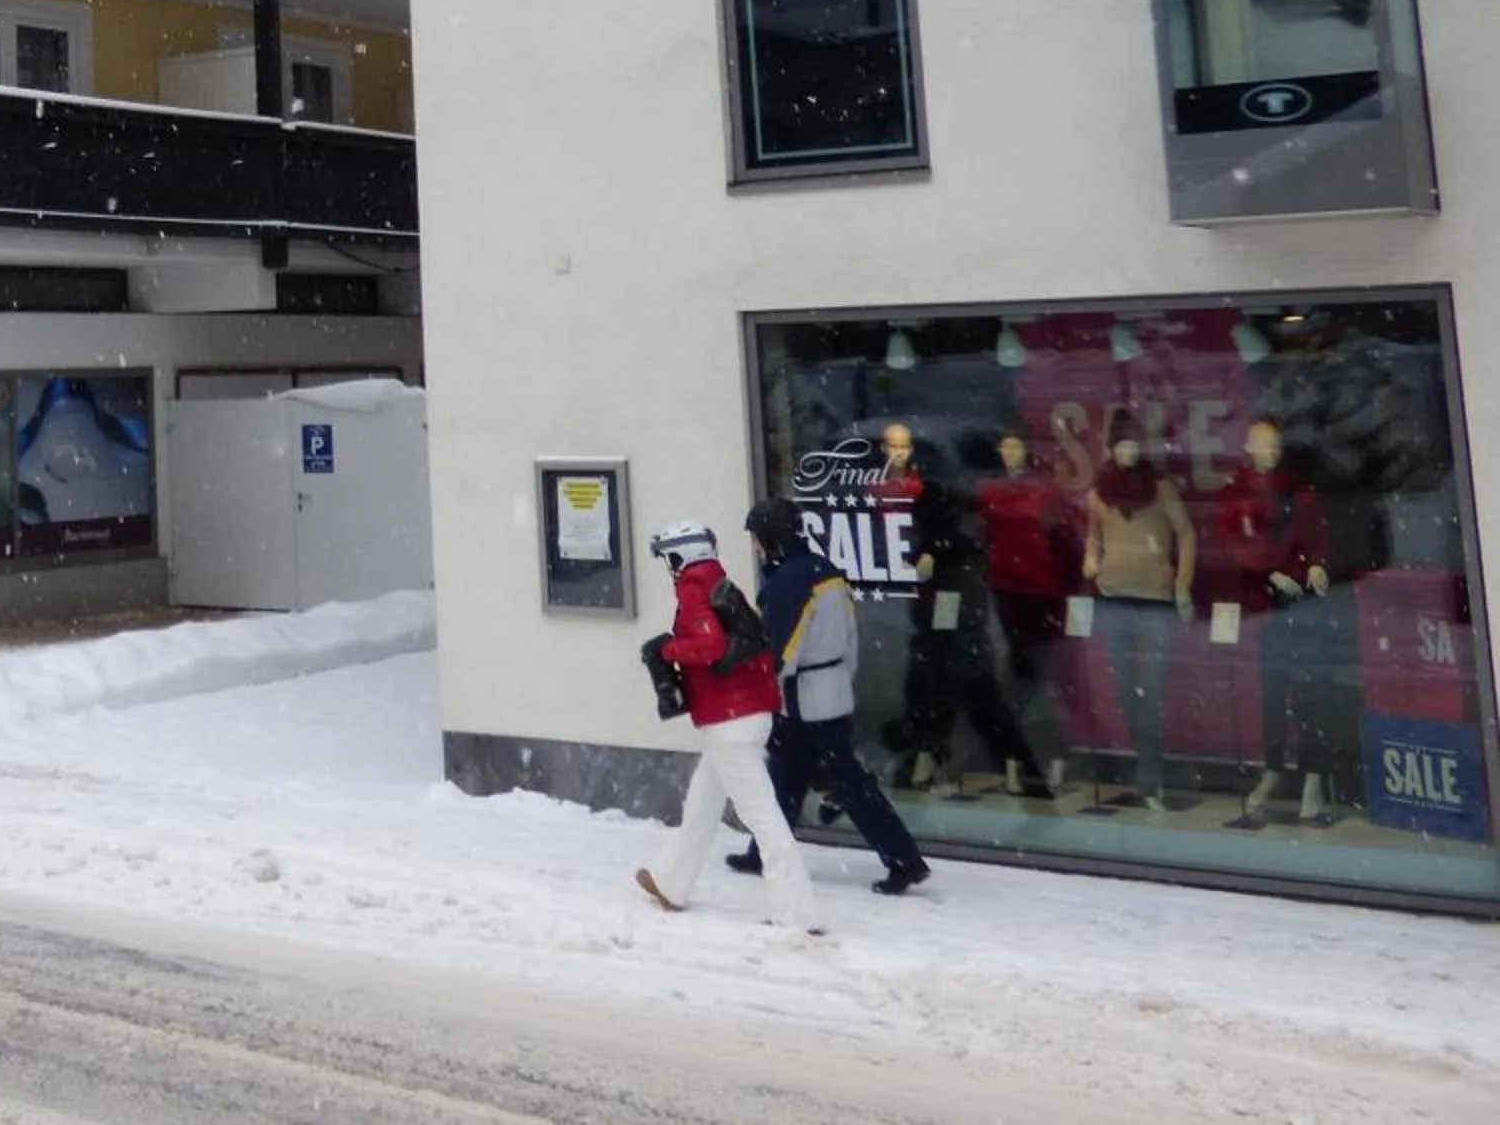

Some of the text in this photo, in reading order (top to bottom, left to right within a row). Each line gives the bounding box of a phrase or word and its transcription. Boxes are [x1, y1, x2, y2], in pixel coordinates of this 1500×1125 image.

[311, 436, 325, 456] P
[791, 438, 892, 492] Final
[1052, 400, 1238, 491] SLE
[1383, 748, 1462, 804] SALE
